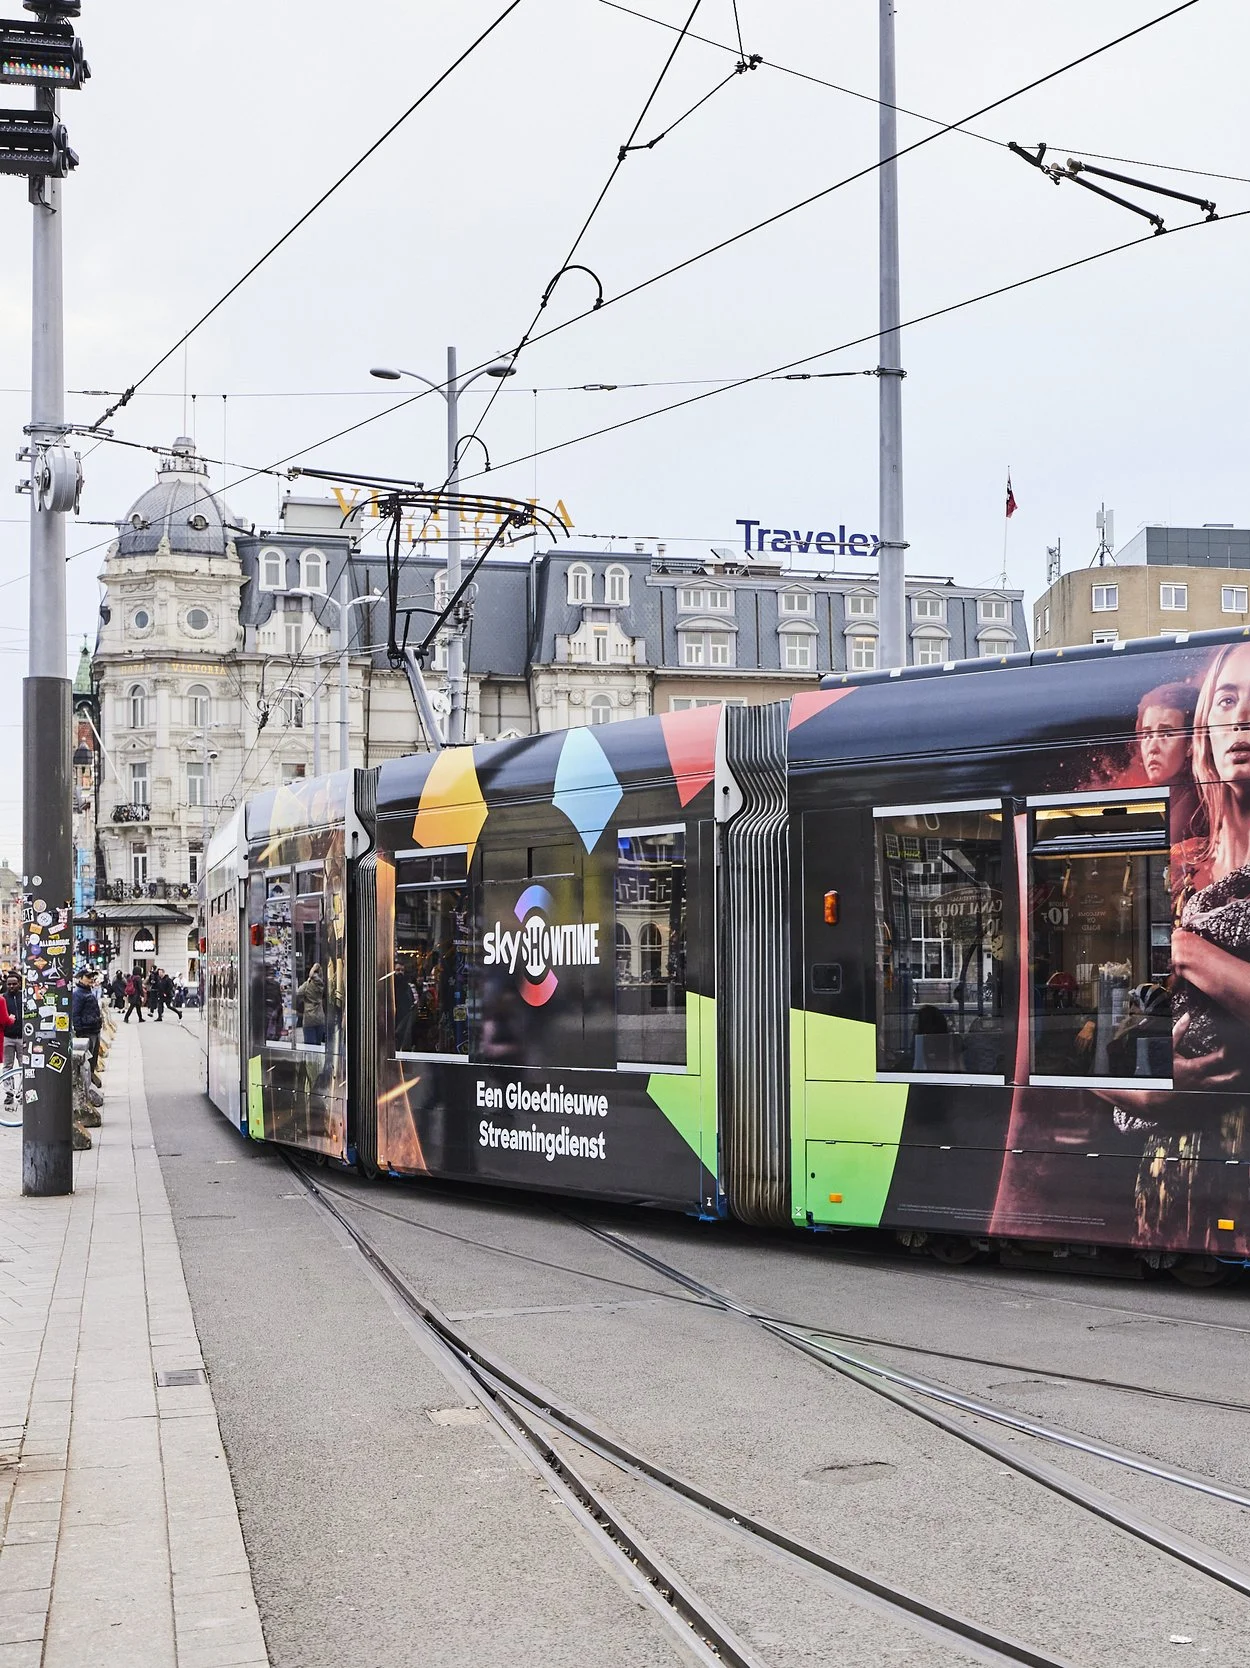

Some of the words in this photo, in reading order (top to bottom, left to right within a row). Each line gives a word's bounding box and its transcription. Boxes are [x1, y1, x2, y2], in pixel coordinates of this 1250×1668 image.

[331, 487, 575, 527] VITORIA
[171, 663, 227, 675] VICTORIA
[476, 1080, 503, 1108] Een
[505, 1081, 609, 1117] Gloednieuwe
[478, 1120, 606, 1162] Streamingdienst
